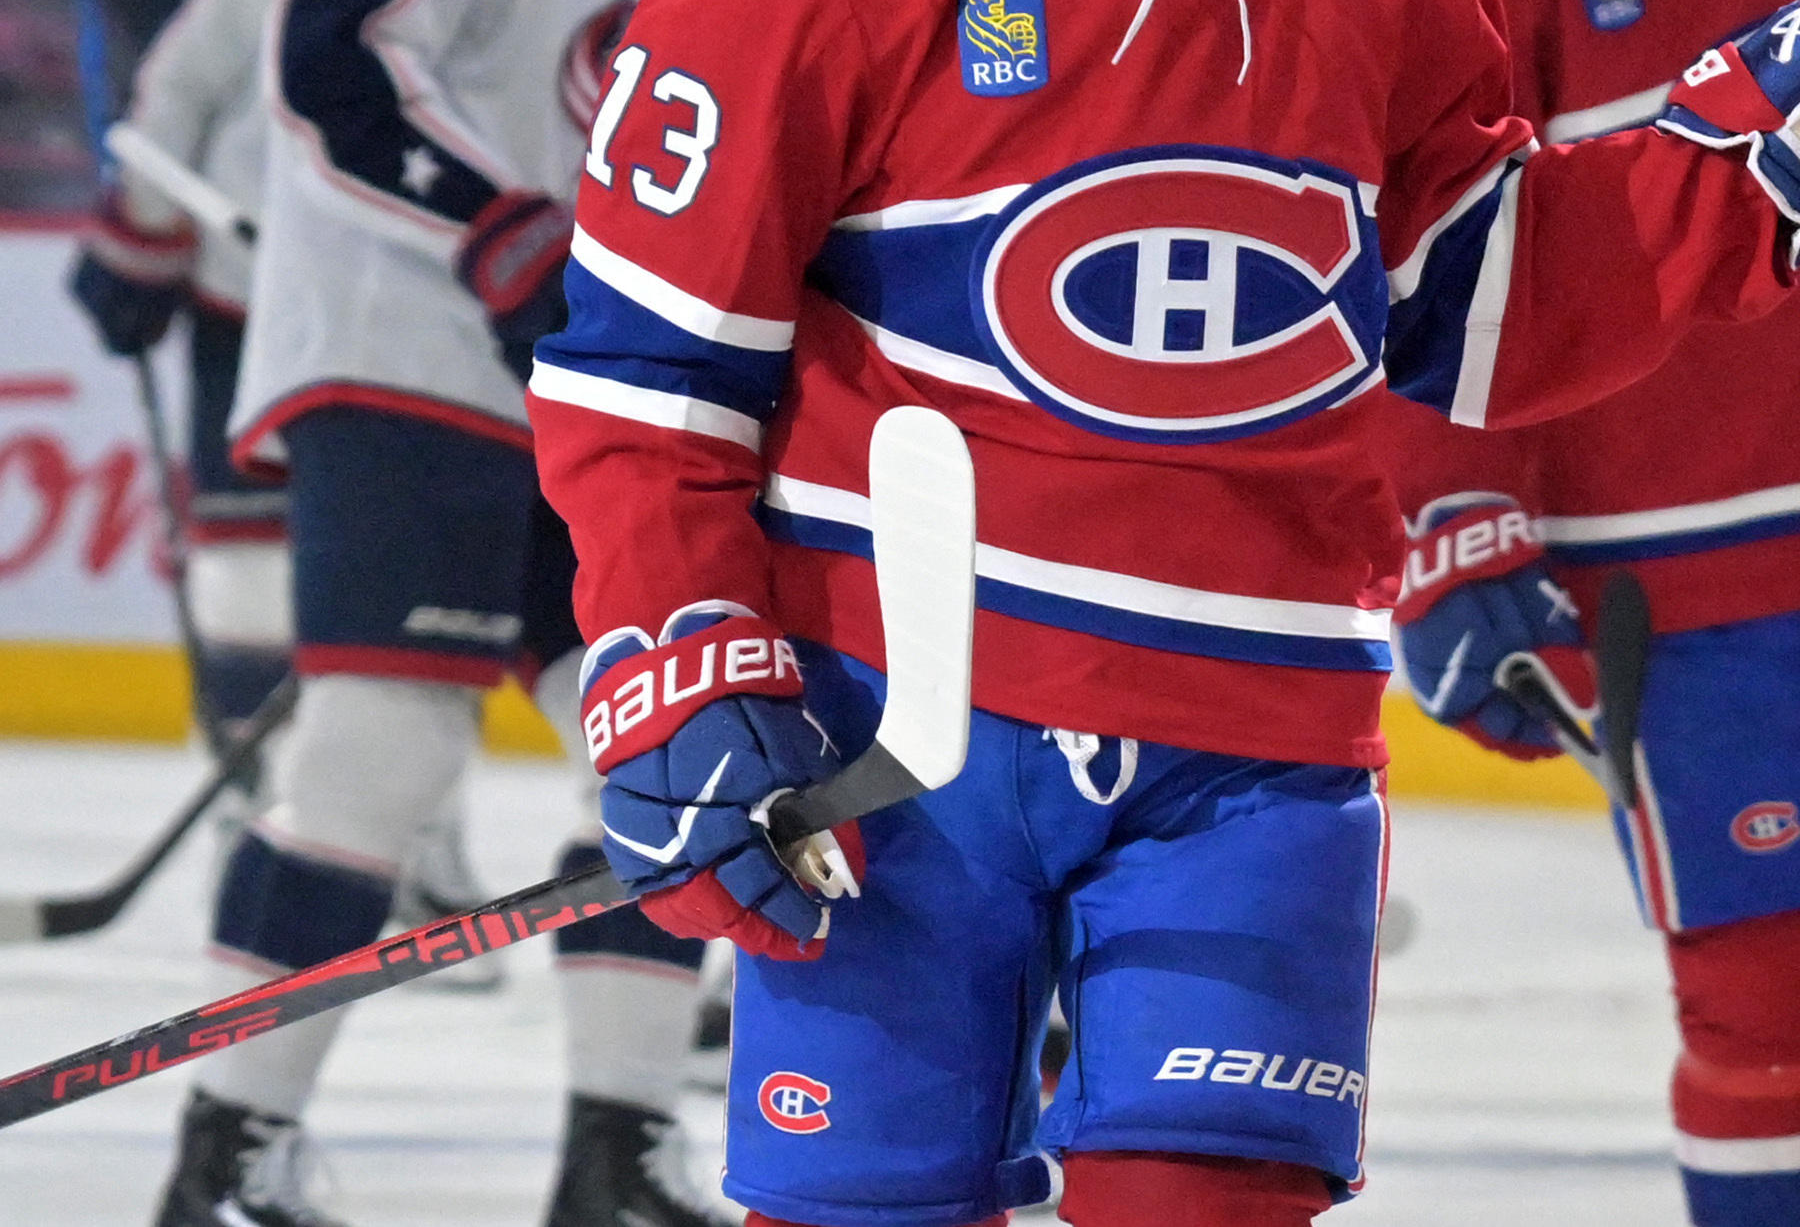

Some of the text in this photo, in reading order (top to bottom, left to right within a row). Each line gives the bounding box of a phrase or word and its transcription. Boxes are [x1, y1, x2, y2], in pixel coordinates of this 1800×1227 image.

[973, 60, 1037, 86] RBC
[585, 43, 722, 219] 13
[1398, 511, 1534, 605] UER
[52, 1006, 282, 1100] PULSE
